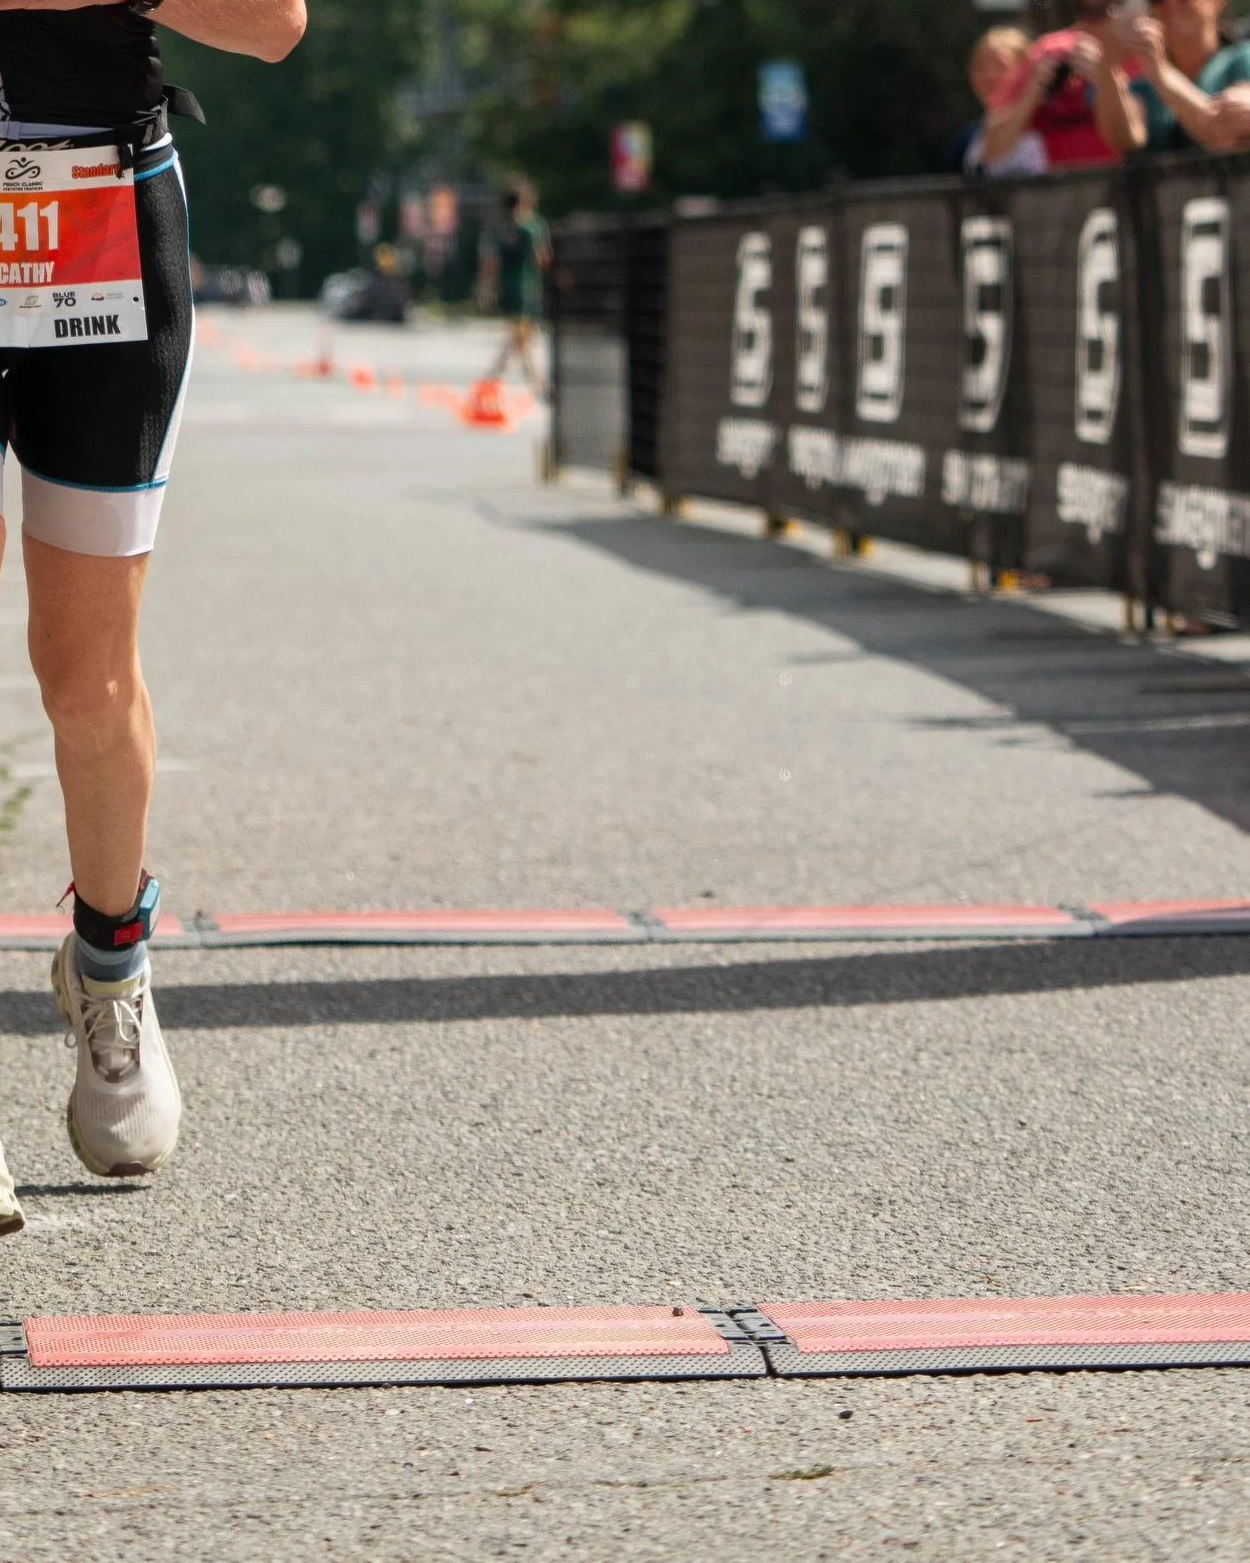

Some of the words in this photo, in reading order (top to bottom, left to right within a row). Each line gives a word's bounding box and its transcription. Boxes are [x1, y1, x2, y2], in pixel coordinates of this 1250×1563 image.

[71, 163, 121, 180] Standar
[52, 291, 76, 299] BLUE
[54, 298, 77, 308] 70
[54, 314, 121, 339] DRINK
